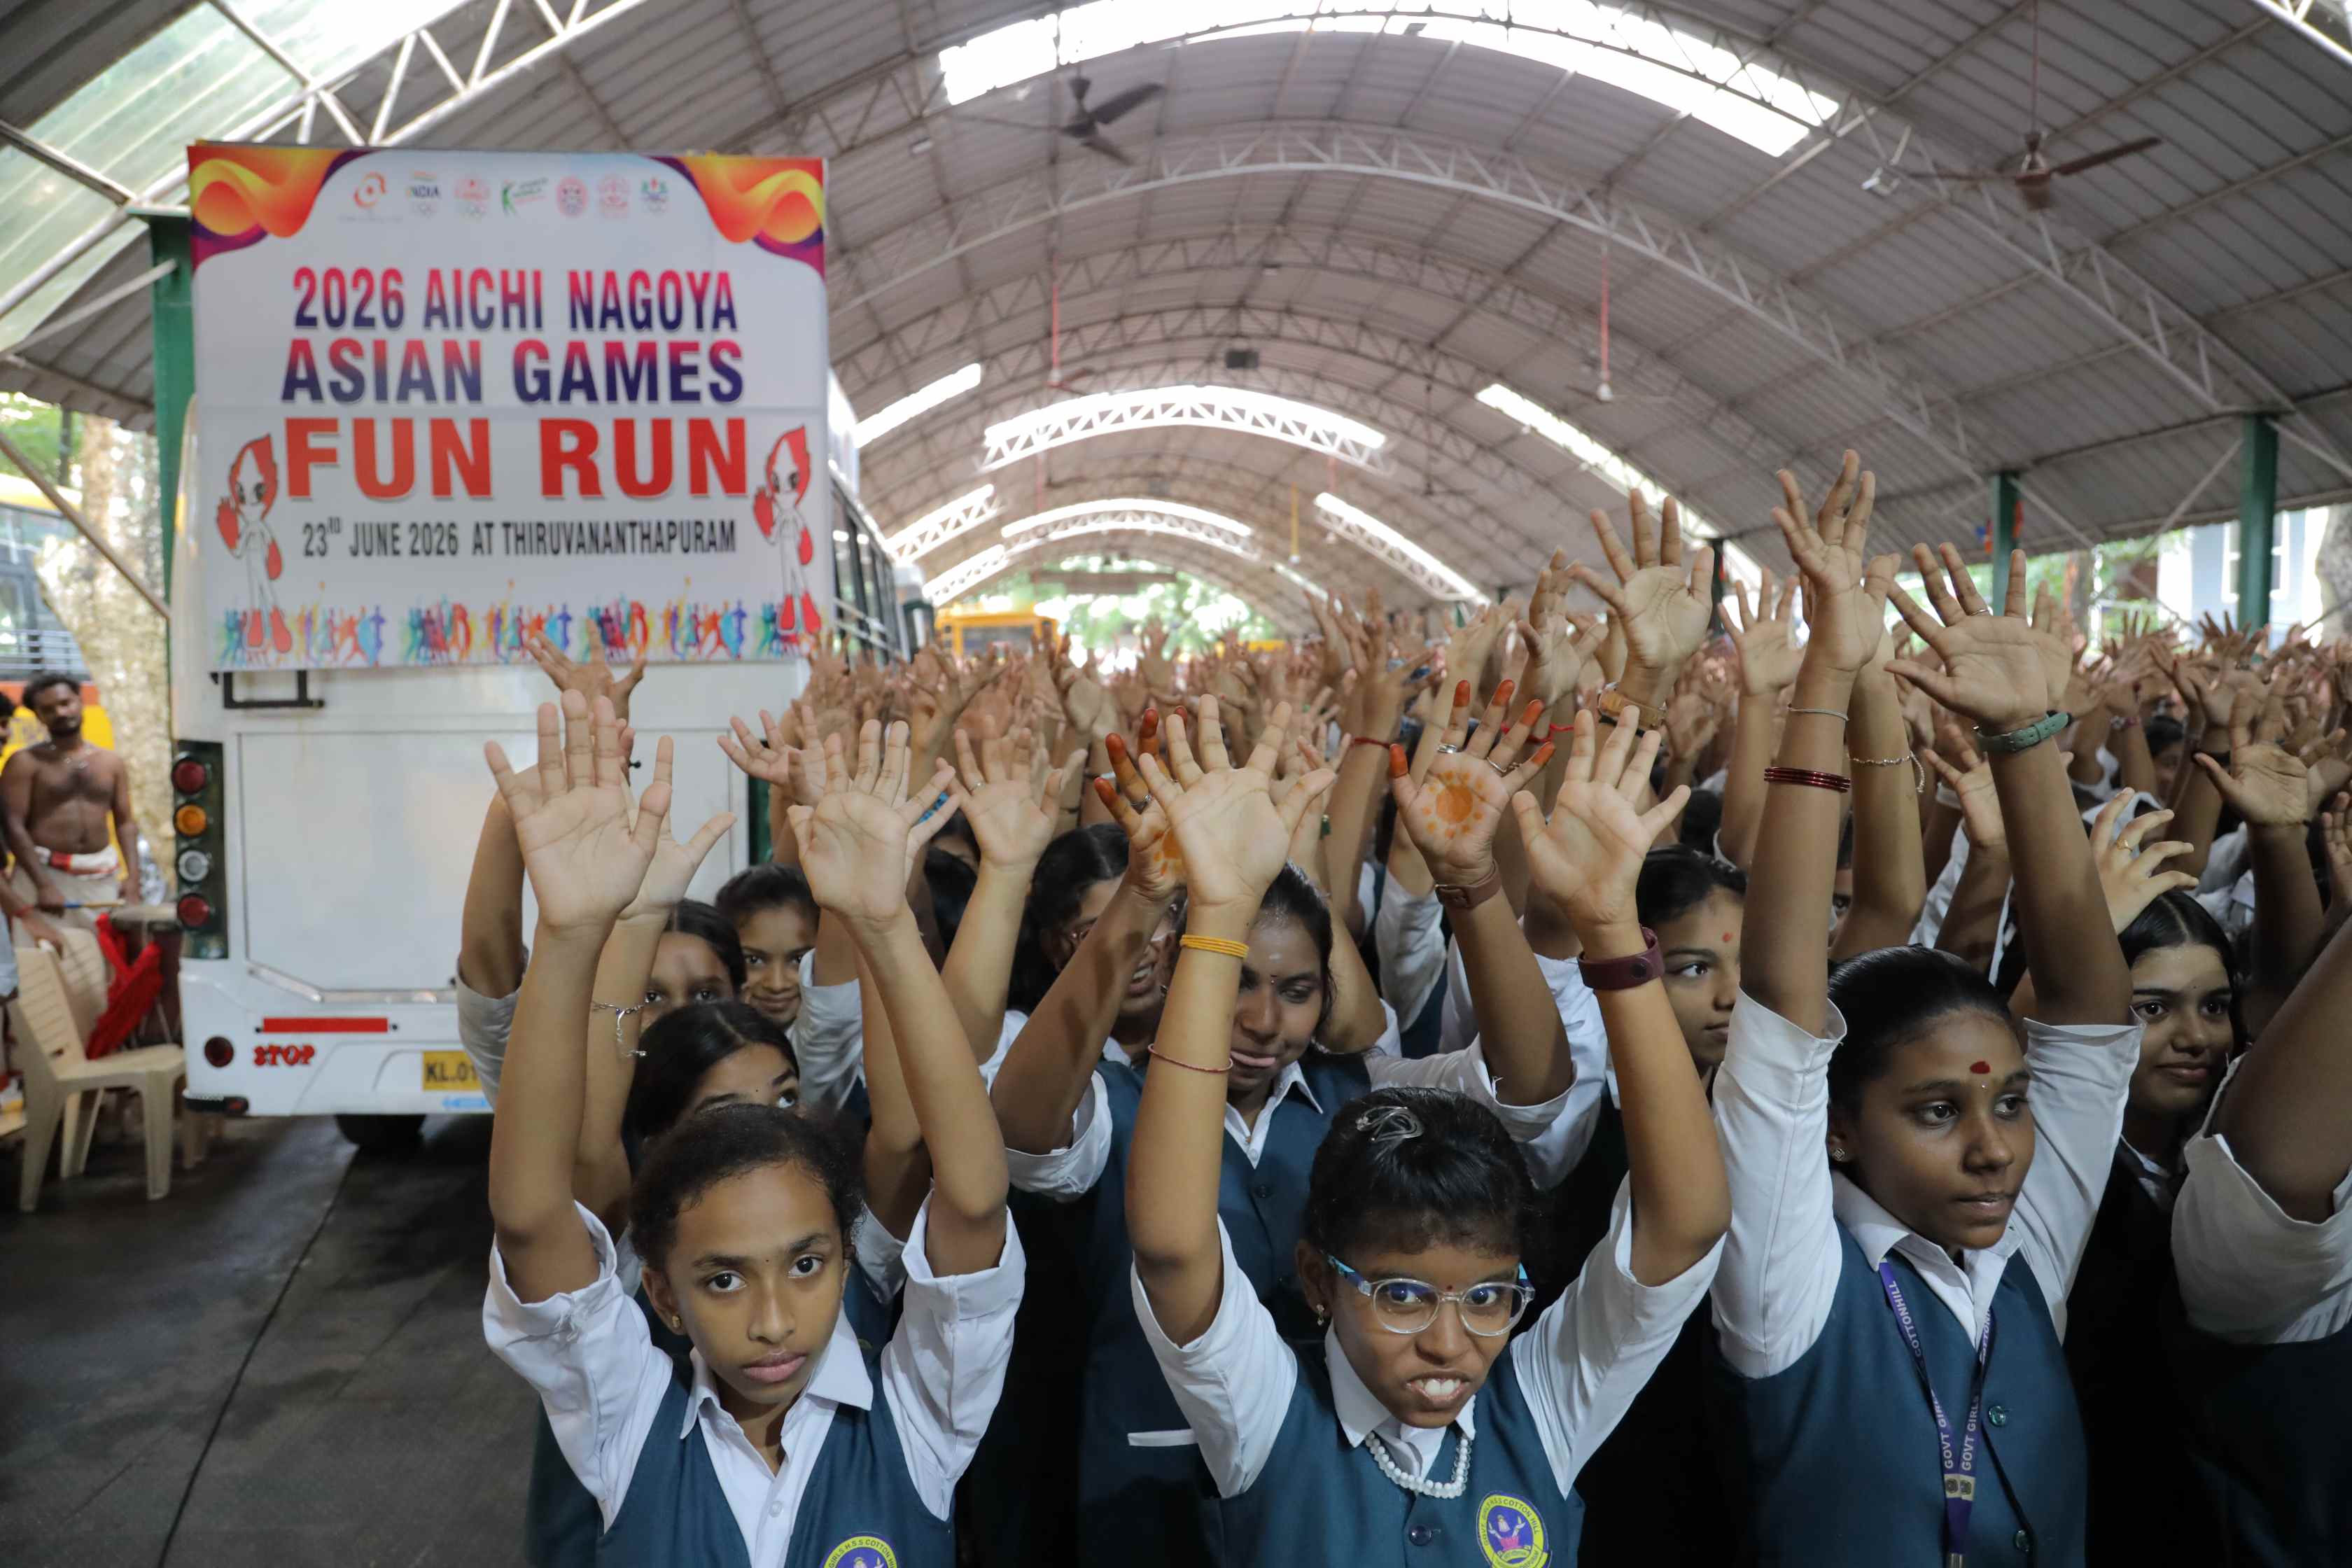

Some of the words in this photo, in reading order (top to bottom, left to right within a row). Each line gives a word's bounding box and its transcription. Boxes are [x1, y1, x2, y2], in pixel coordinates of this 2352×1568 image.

[293, 267, 404, 330] 2026
[424, 268, 542, 330] AICHI
[568, 270, 738, 332] NAGOYA
[281, 338, 482, 404] ASIAN
[513, 340, 743, 405] GAMES
[285, 417, 492, 500] FUN
[539, 418, 747, 500] RUN
[350, 522, 400, 556] JUNE
[409, 522, 458, 556] 2026
[472, 522, 494, 554] AT
[502, 520, 735, 555] THIRUVANANTHAPURAM
[253, 1044, 316, 1067] STOP
[1889, 1280, 1921, 1357] COTTONHILL
[1940, 1433, 1954, 1469] GOVT
[1961, 1435, 1975, 1471] GOVT
[1503, 1498, 1532, 1517] COTTON
[865, 1539, 890, 1558] COTTON
